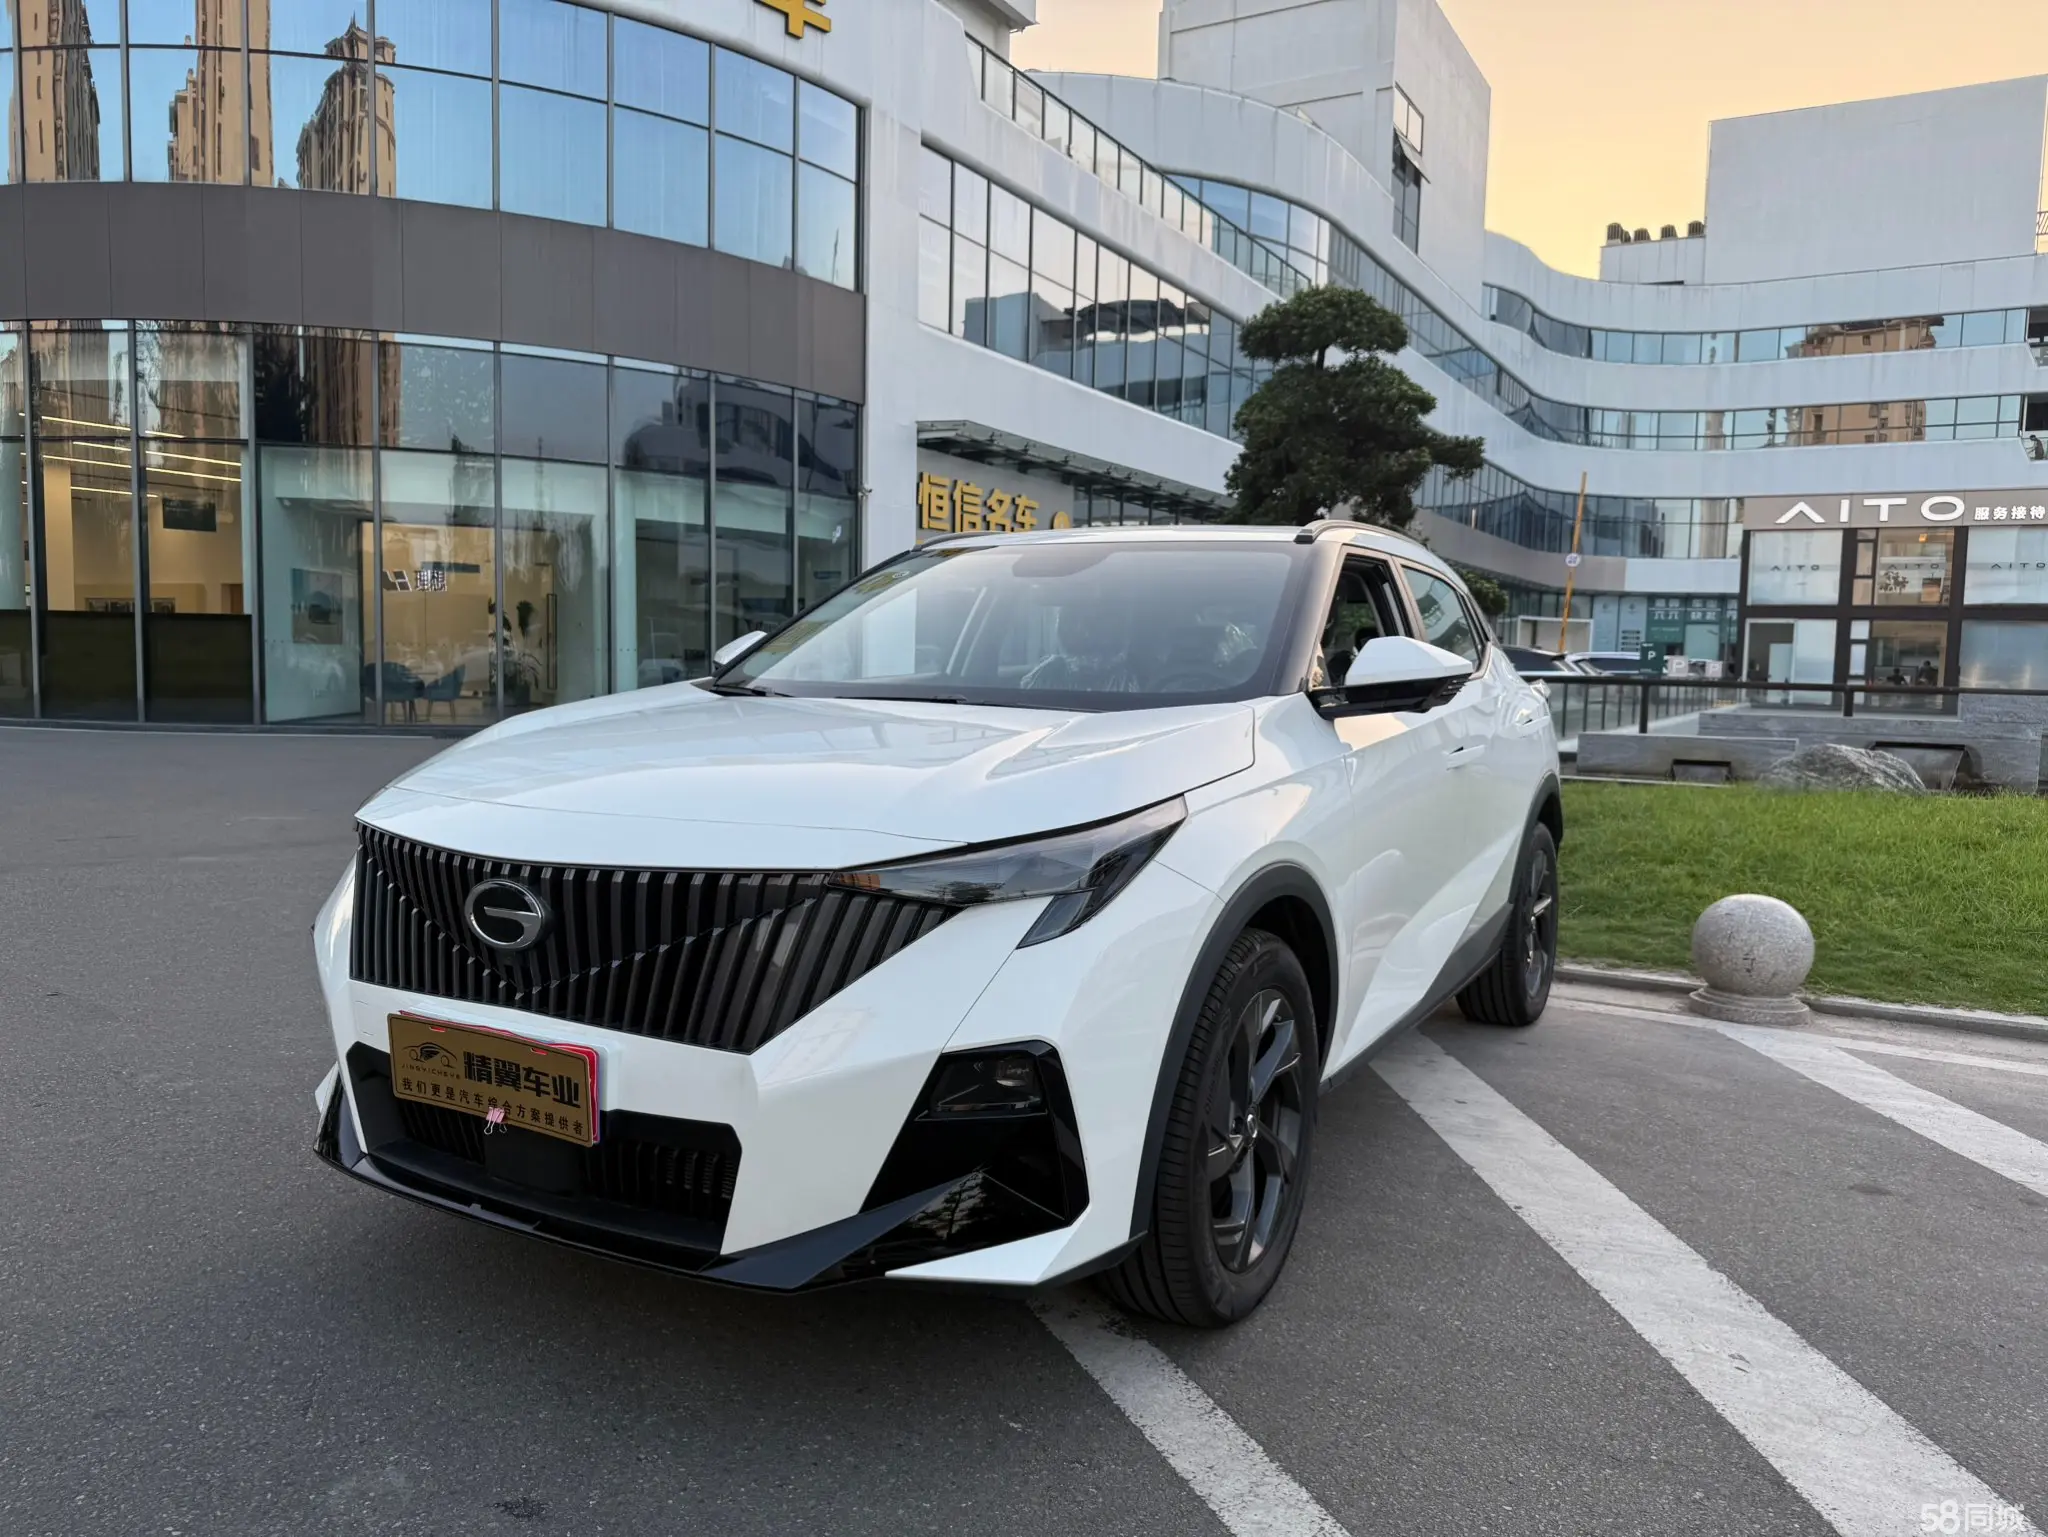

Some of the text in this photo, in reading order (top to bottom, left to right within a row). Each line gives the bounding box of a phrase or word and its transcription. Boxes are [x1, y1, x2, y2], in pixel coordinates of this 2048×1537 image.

[918, 471, 1040, 533] 恒信名车
[1775, 496, 2046, 524] AITO 服务接待
[1648, 650, 1656, 660] P
[1673, 661, 1686, 675] P
[463, 1051, 581, 1109] 精翼车业
[402, 1077, 584, 1136] 我们更是汽车综合方案提供者
